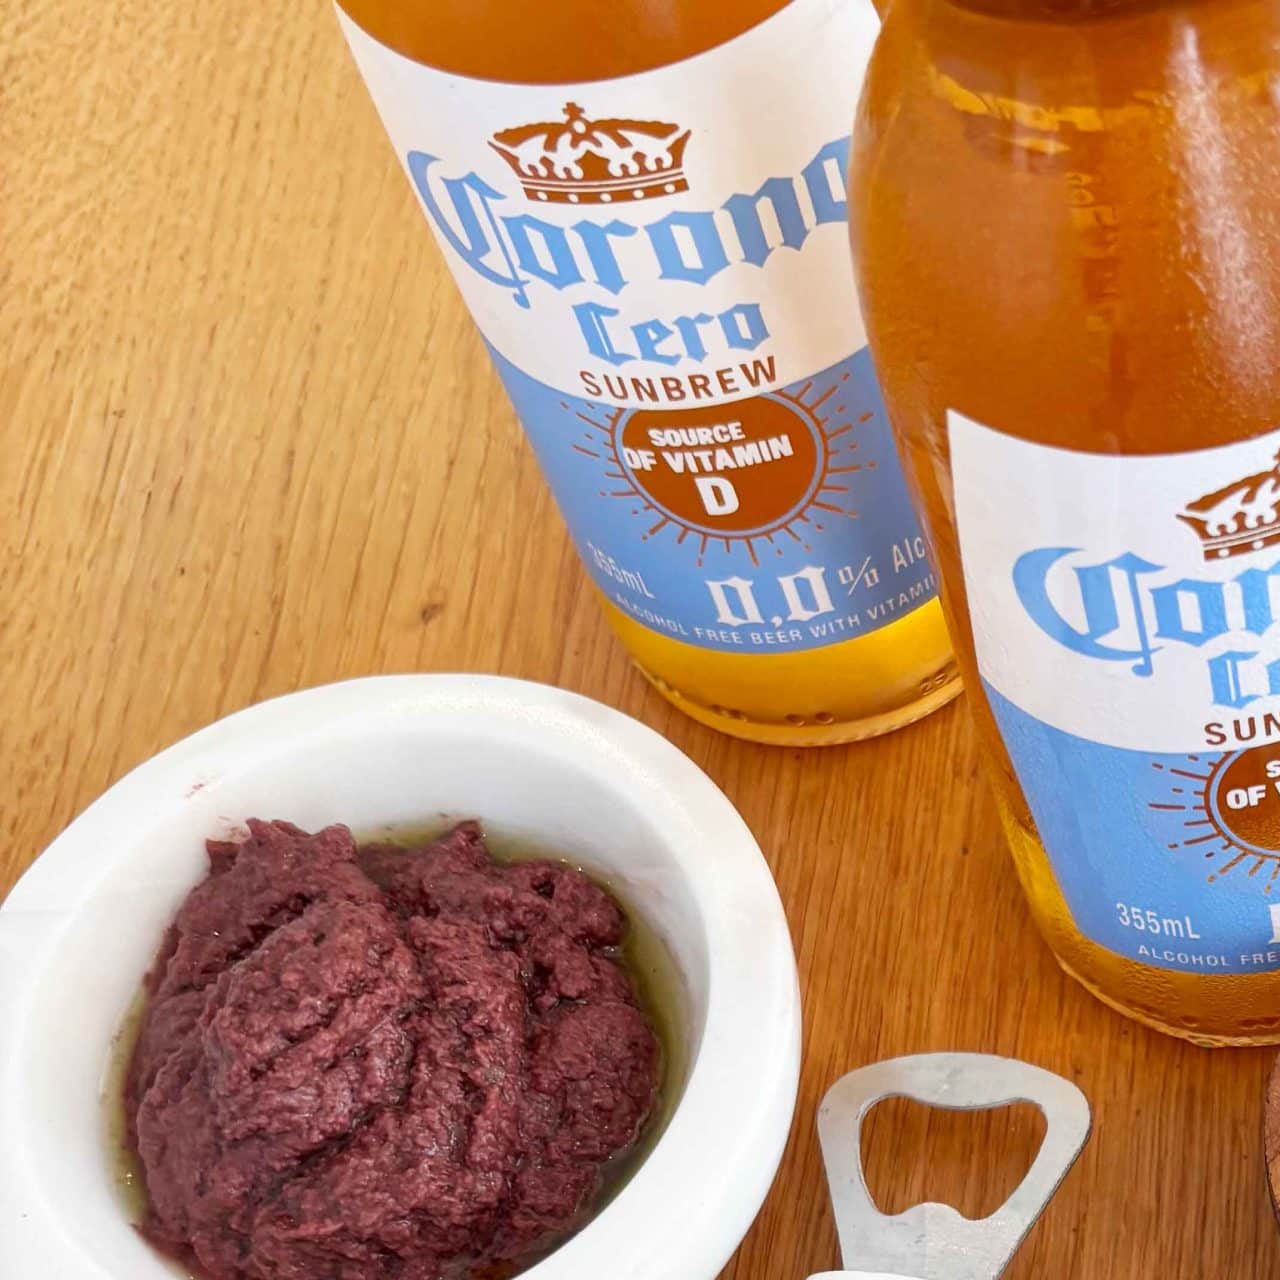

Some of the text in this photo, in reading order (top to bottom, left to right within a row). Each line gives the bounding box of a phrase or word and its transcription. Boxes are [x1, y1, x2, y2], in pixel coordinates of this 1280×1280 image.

[406, 134, 851, 309] Corona
[571, 301, 771, 367] Cero
[579, 355, 777, 403] SUNBREW
[622, 434, 794, 474] OF VITAMIN
[647, 421, 746, 448] SOURCE
[694, 476, 740, 516] D
[616, 592, 690, 638] ALCOHOL
[693, 626, 744, 645] FREE
[750, 627, 803, 645] BEER
[809, 614, 862, 639] WITH
[1225, 784, 1267, 810] OF
[1115, 901, 1201, 940] 355mL
[1137, 944, 1232, 968] ALCOHOL
